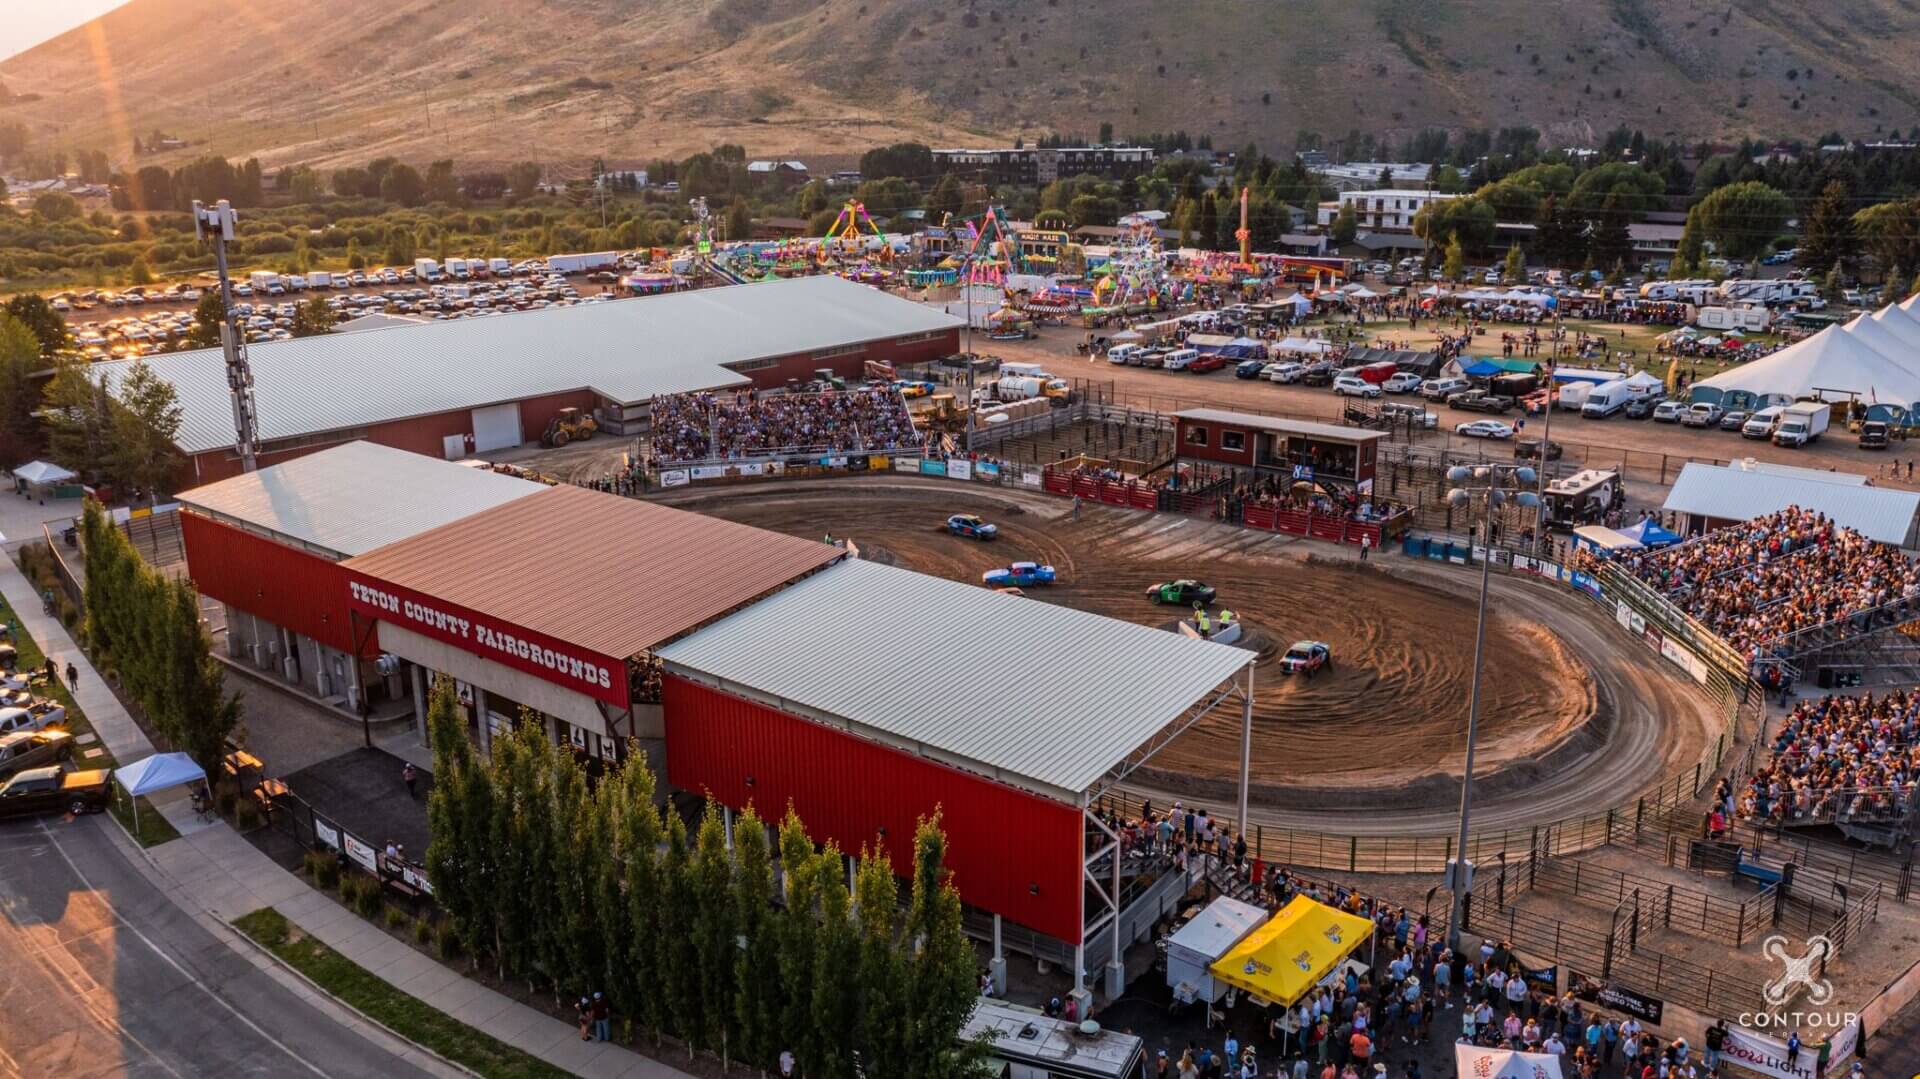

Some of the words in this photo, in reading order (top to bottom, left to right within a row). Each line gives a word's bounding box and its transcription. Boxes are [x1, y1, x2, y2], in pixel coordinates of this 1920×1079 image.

[350, 581, 400, 614] TETON
[404, 600, 470, 638] COUNTY
[475, 624, 611, 689] FAIRGROUNDS
[1766, 1056, 1812, 1079] LIGHT
